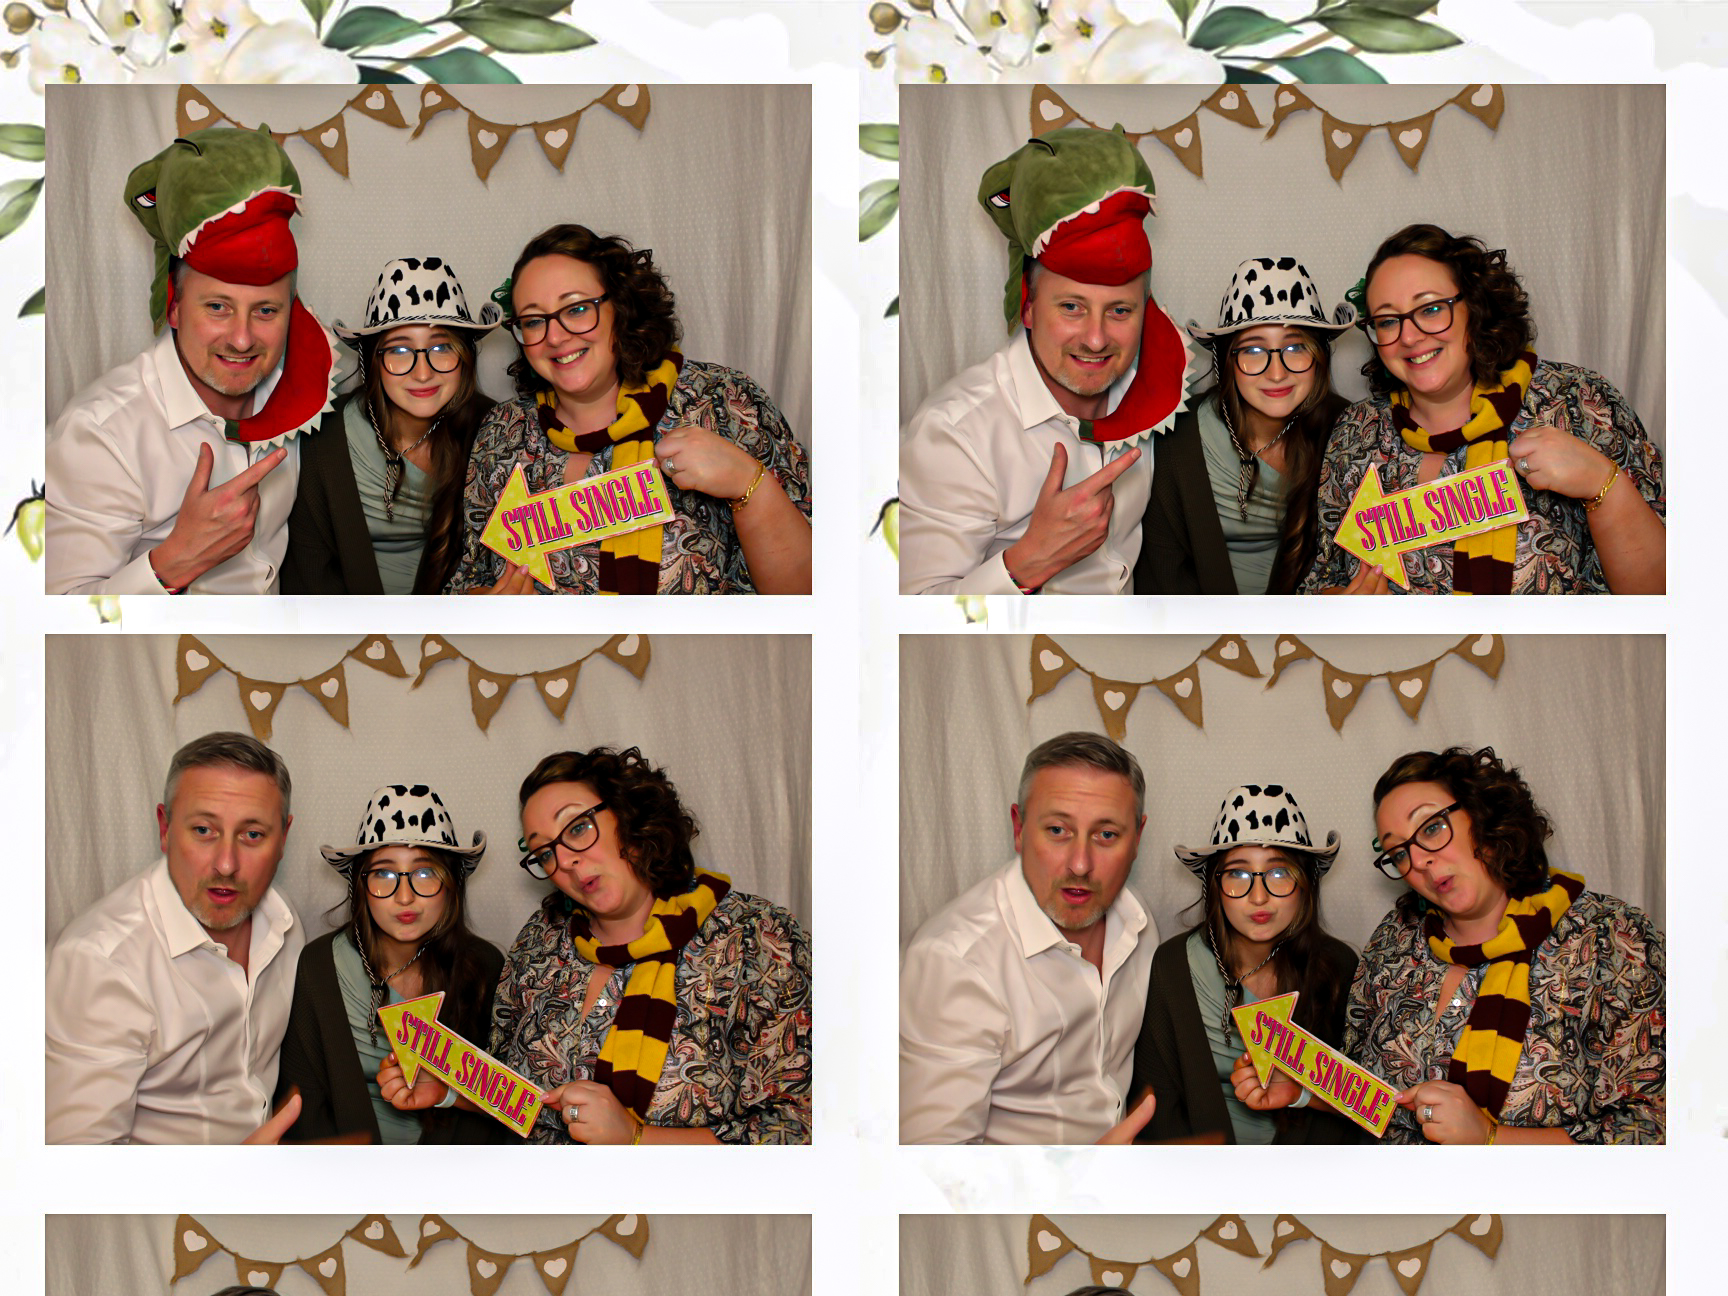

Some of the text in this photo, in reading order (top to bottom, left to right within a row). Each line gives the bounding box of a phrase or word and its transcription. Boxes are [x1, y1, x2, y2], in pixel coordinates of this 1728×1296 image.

[500, 468, 664, 551] STILL SINGLE
[1354, 468, 1517, 551] STILL SINGLE
[396, 1010, 536, 1127] STILL SINGLE
[1250, 1010, 1390, 1127] STILL SINGLE
